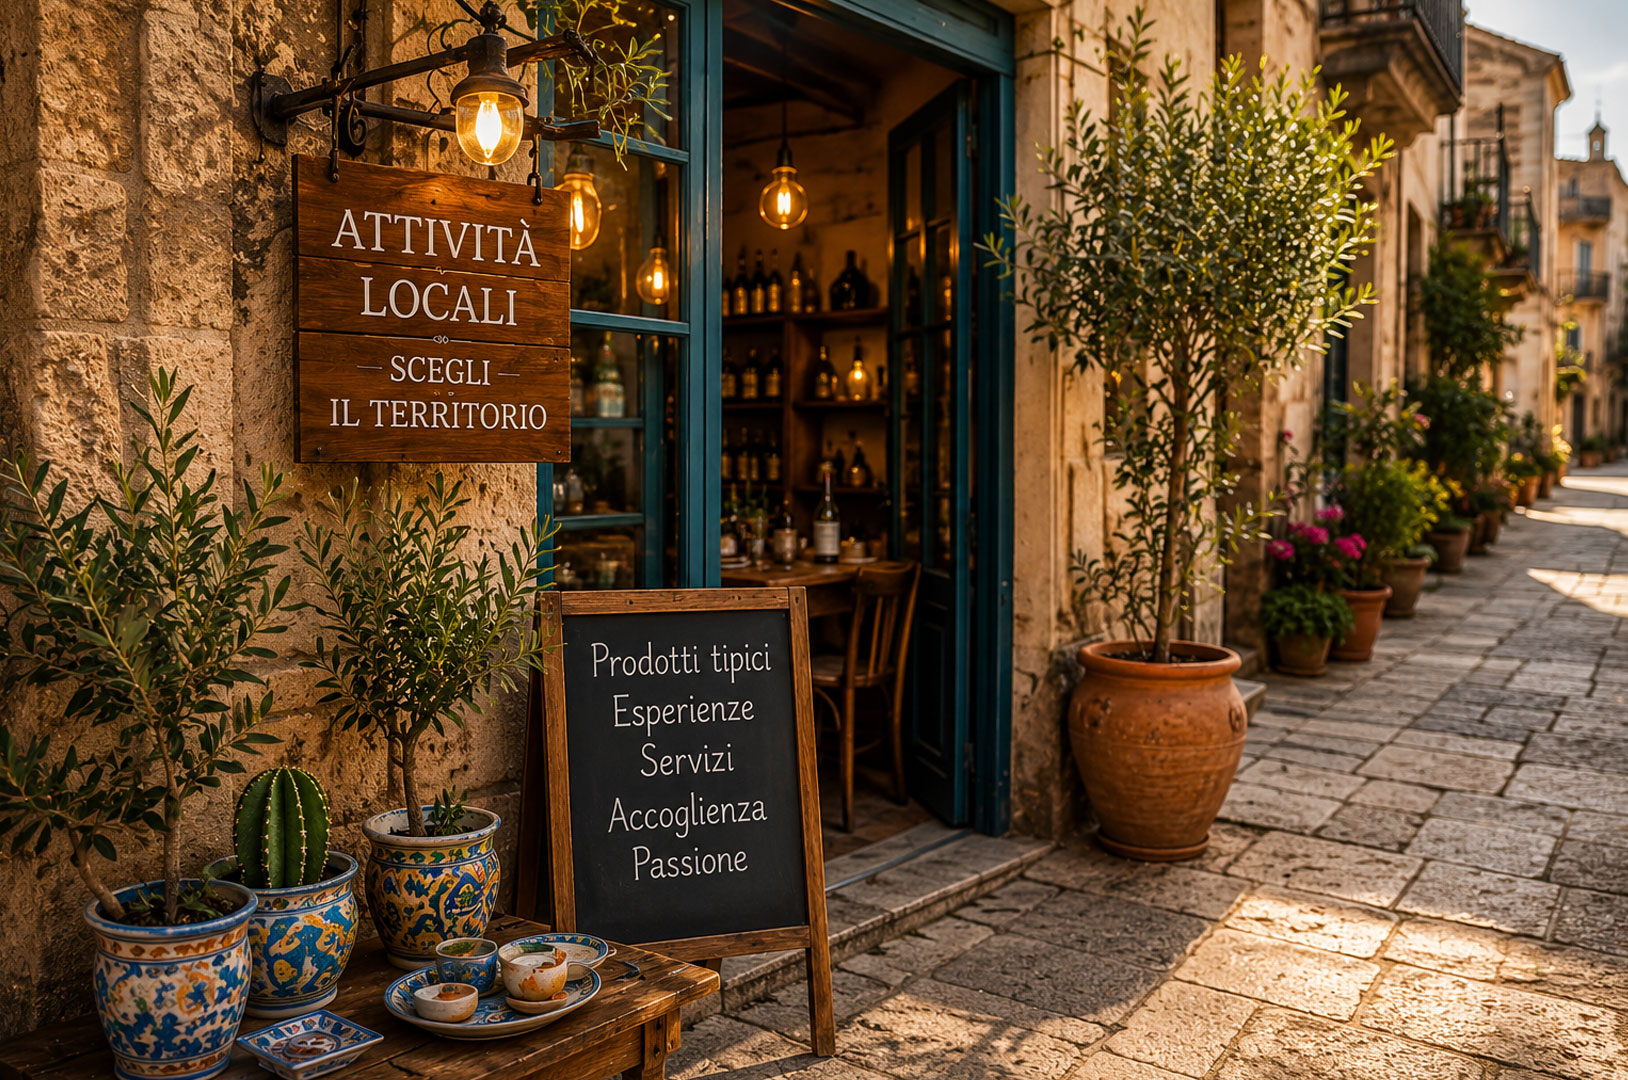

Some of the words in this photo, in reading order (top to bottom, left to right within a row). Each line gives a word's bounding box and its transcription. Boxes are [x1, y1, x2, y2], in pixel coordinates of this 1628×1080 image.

[331, 208, 541, 268] ATTIVITÀ
[360, 276, 518, 326] LOCALI
[390, 355, 491, 386] SCEGLI
[329, 398, 361, 428] IL
[369, 399, 547, 431] TERRITORIO
[590, 641, 701, 678] Prodotti
[710, 643, 772, 684] tipici
[612, 693, 755, 737] Esperienze
[640, 742, 735, 777] Servizi
[608, 791, 768, 838] Accoglienza
[631, 845, 749, 881] Passione
